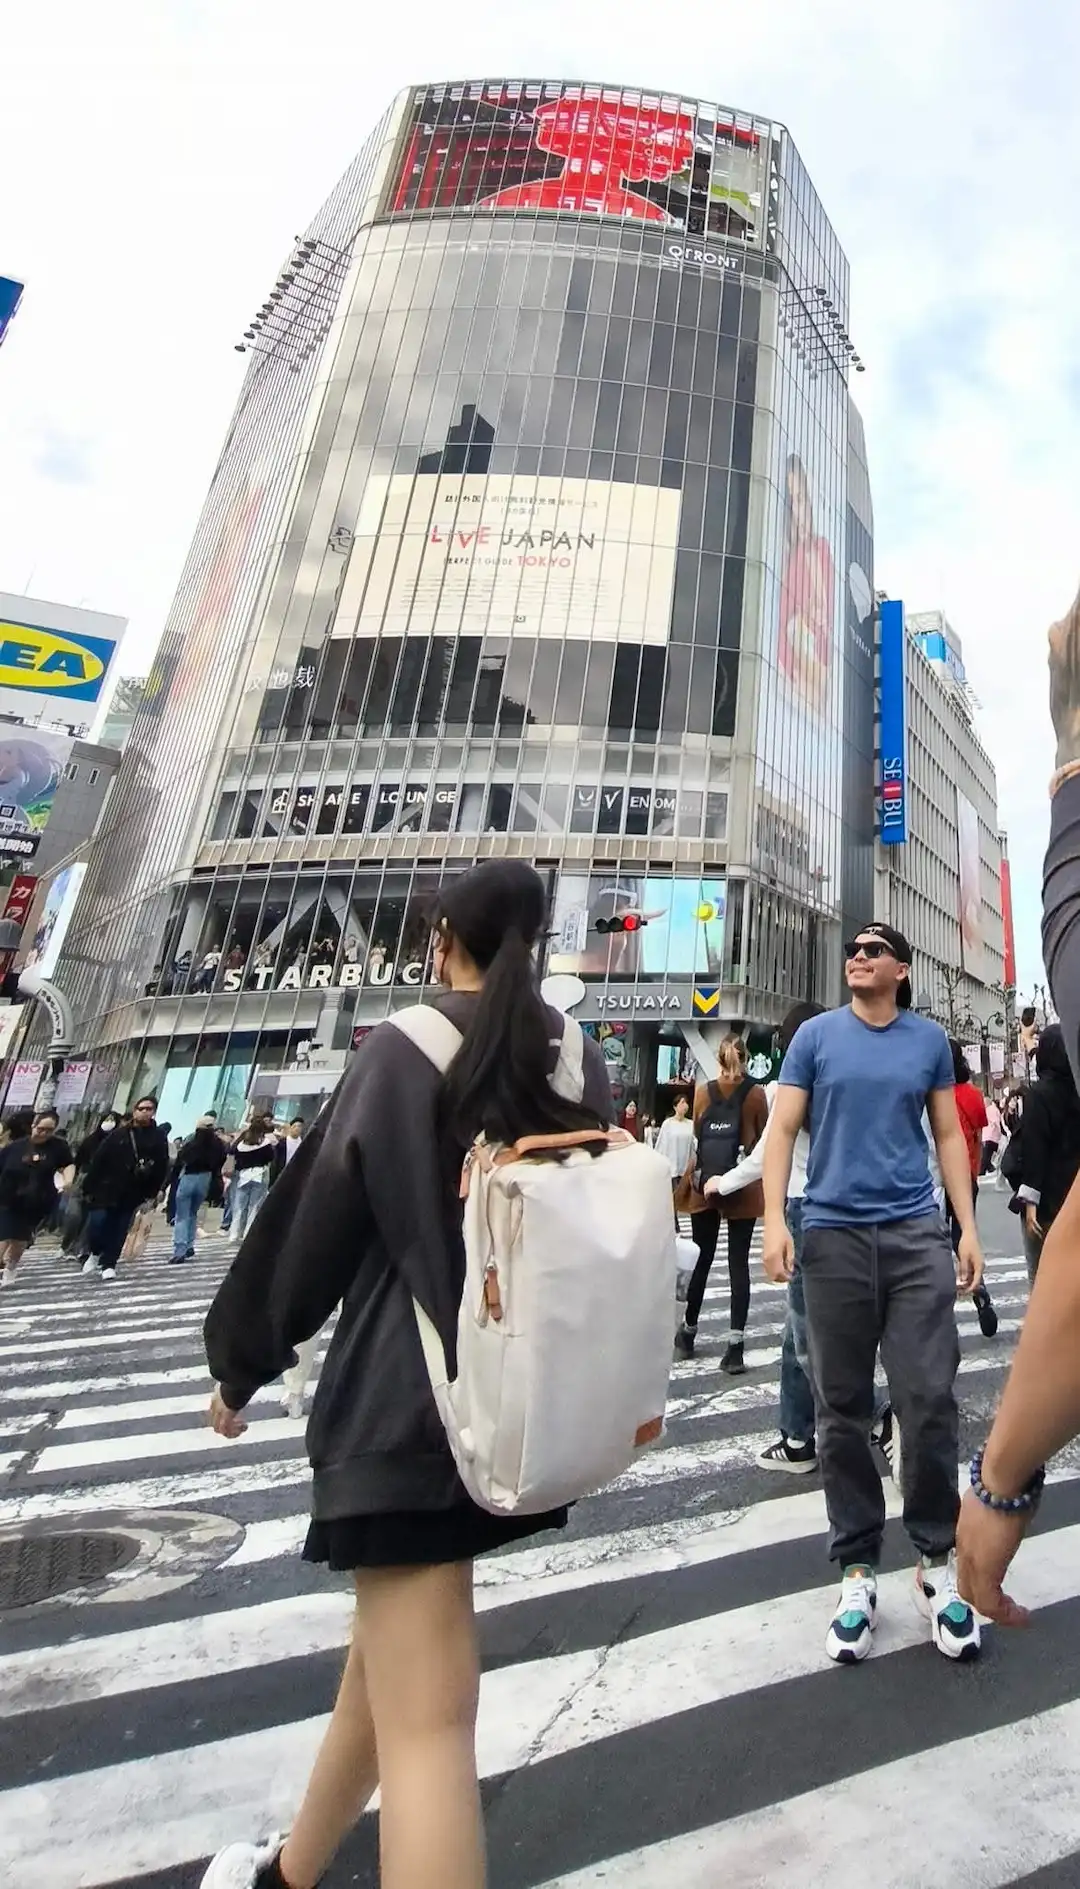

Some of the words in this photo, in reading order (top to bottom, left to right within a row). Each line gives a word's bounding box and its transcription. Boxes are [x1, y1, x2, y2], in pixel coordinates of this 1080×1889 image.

[502, 529, 595, 550] JAPAN
[517, 556, 571, 568] TOKYO
[884, 757, 903, 828] SEIBU
[596, 995, 681, 1009] TSUTAYA
[17, 1063, 41, 1074] NO
[66, 1064, 89, 1074] NO
